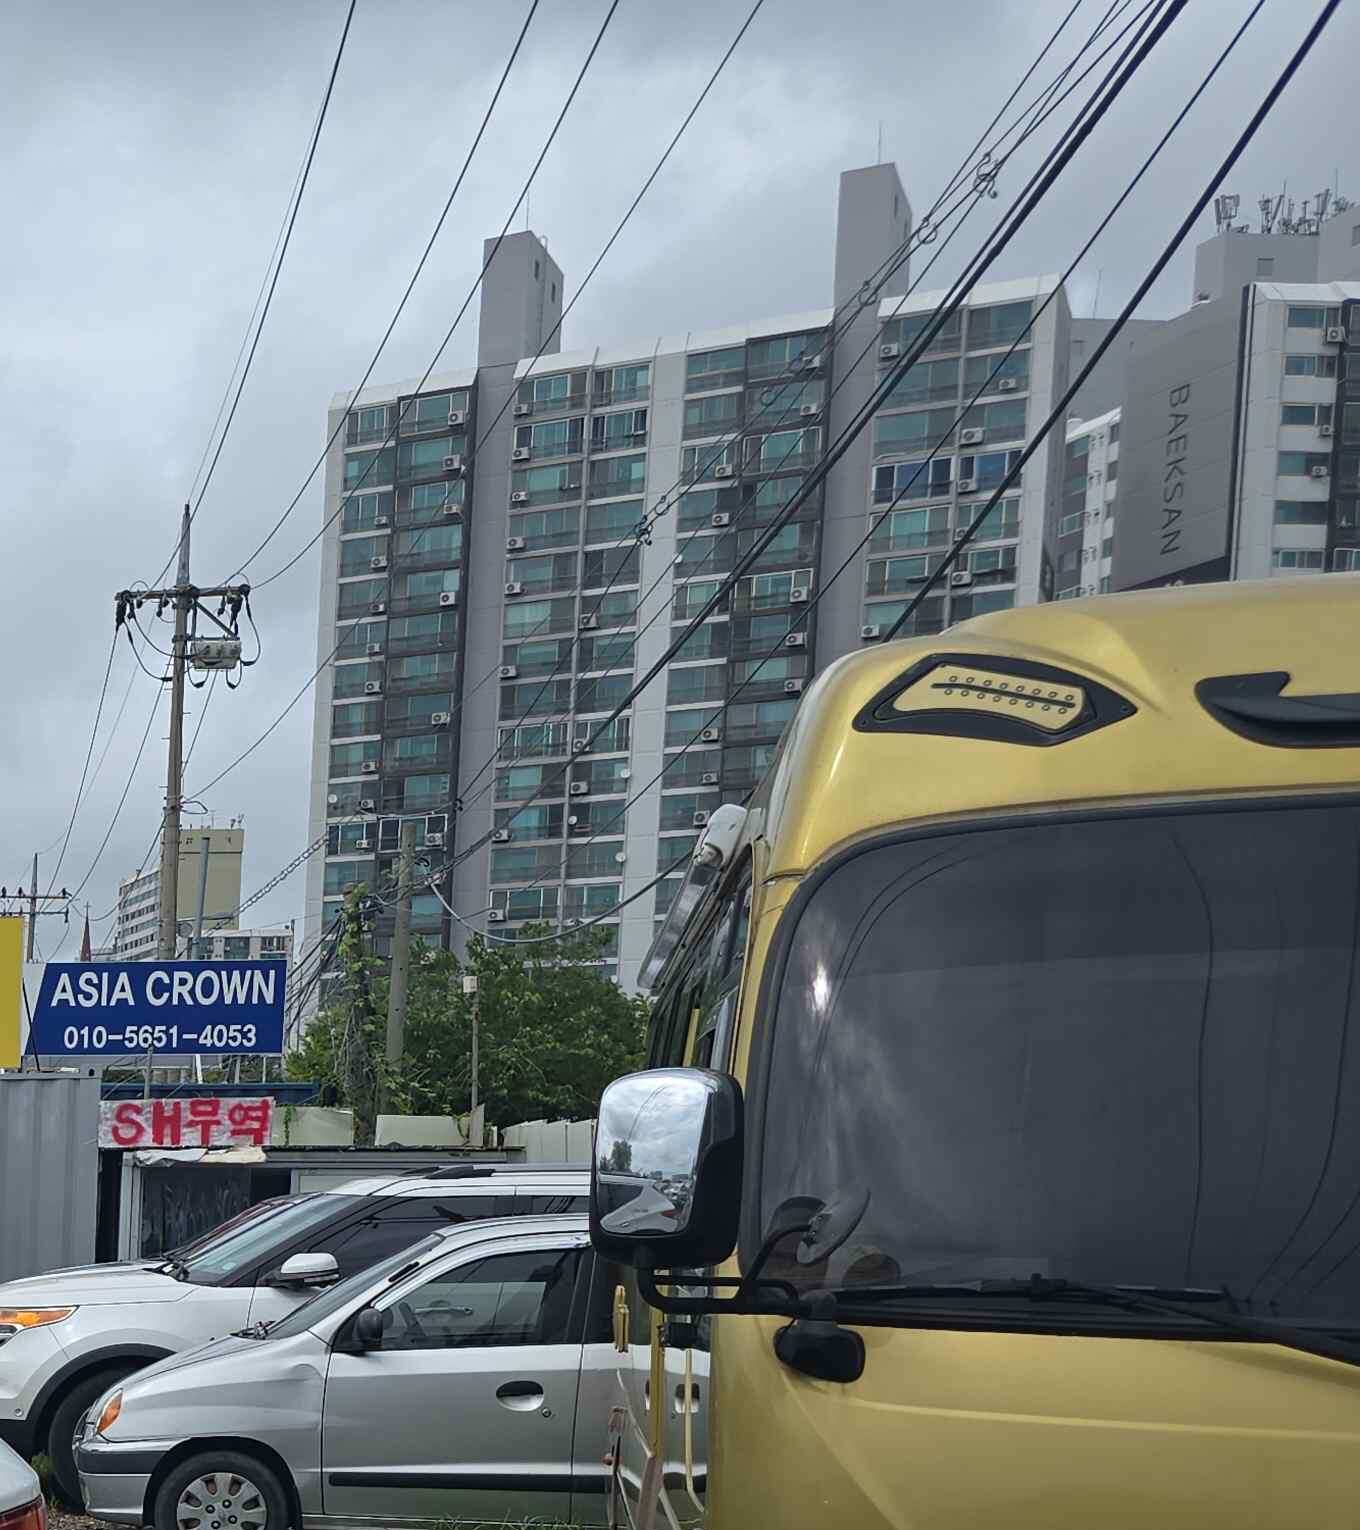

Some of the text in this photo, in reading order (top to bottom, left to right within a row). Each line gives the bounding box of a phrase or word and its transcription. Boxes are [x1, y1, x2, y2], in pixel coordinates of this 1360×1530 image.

[1159, 383, 1191, 556] BAEKSAN
[50, 969, 276, 1008] ASIA CROWN
[63, 1024, 257, 1049] 010-5651-4053
